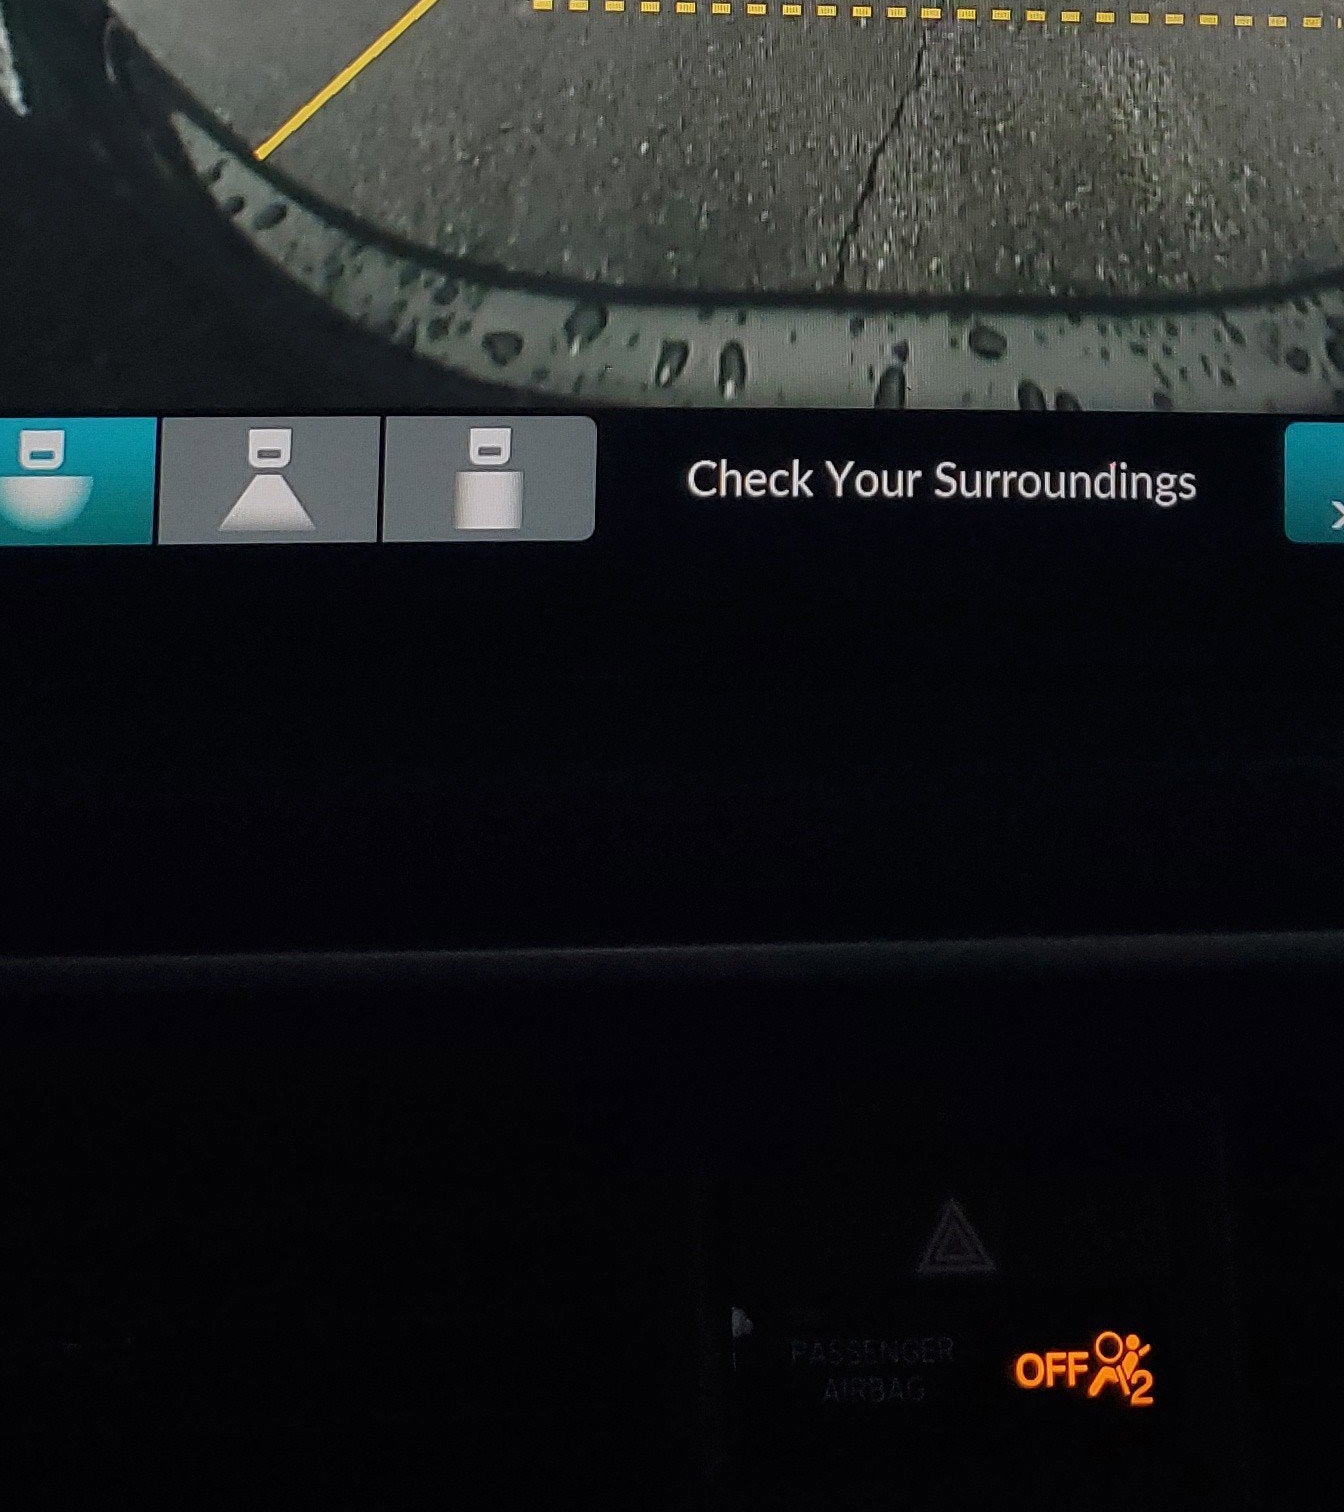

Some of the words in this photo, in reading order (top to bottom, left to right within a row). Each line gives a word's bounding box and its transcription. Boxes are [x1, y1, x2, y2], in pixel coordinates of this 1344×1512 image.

[687, 458, 814, 498] Check
[825, 460, 923, 498] Your
[934, 461, 1197, 508] Surroundings
[790, 1336, 955, 1364] PASSENGER
[1015, 1351, 1089, 1389] OFF
[823, 1376, 926, 1403] AIRBAG
